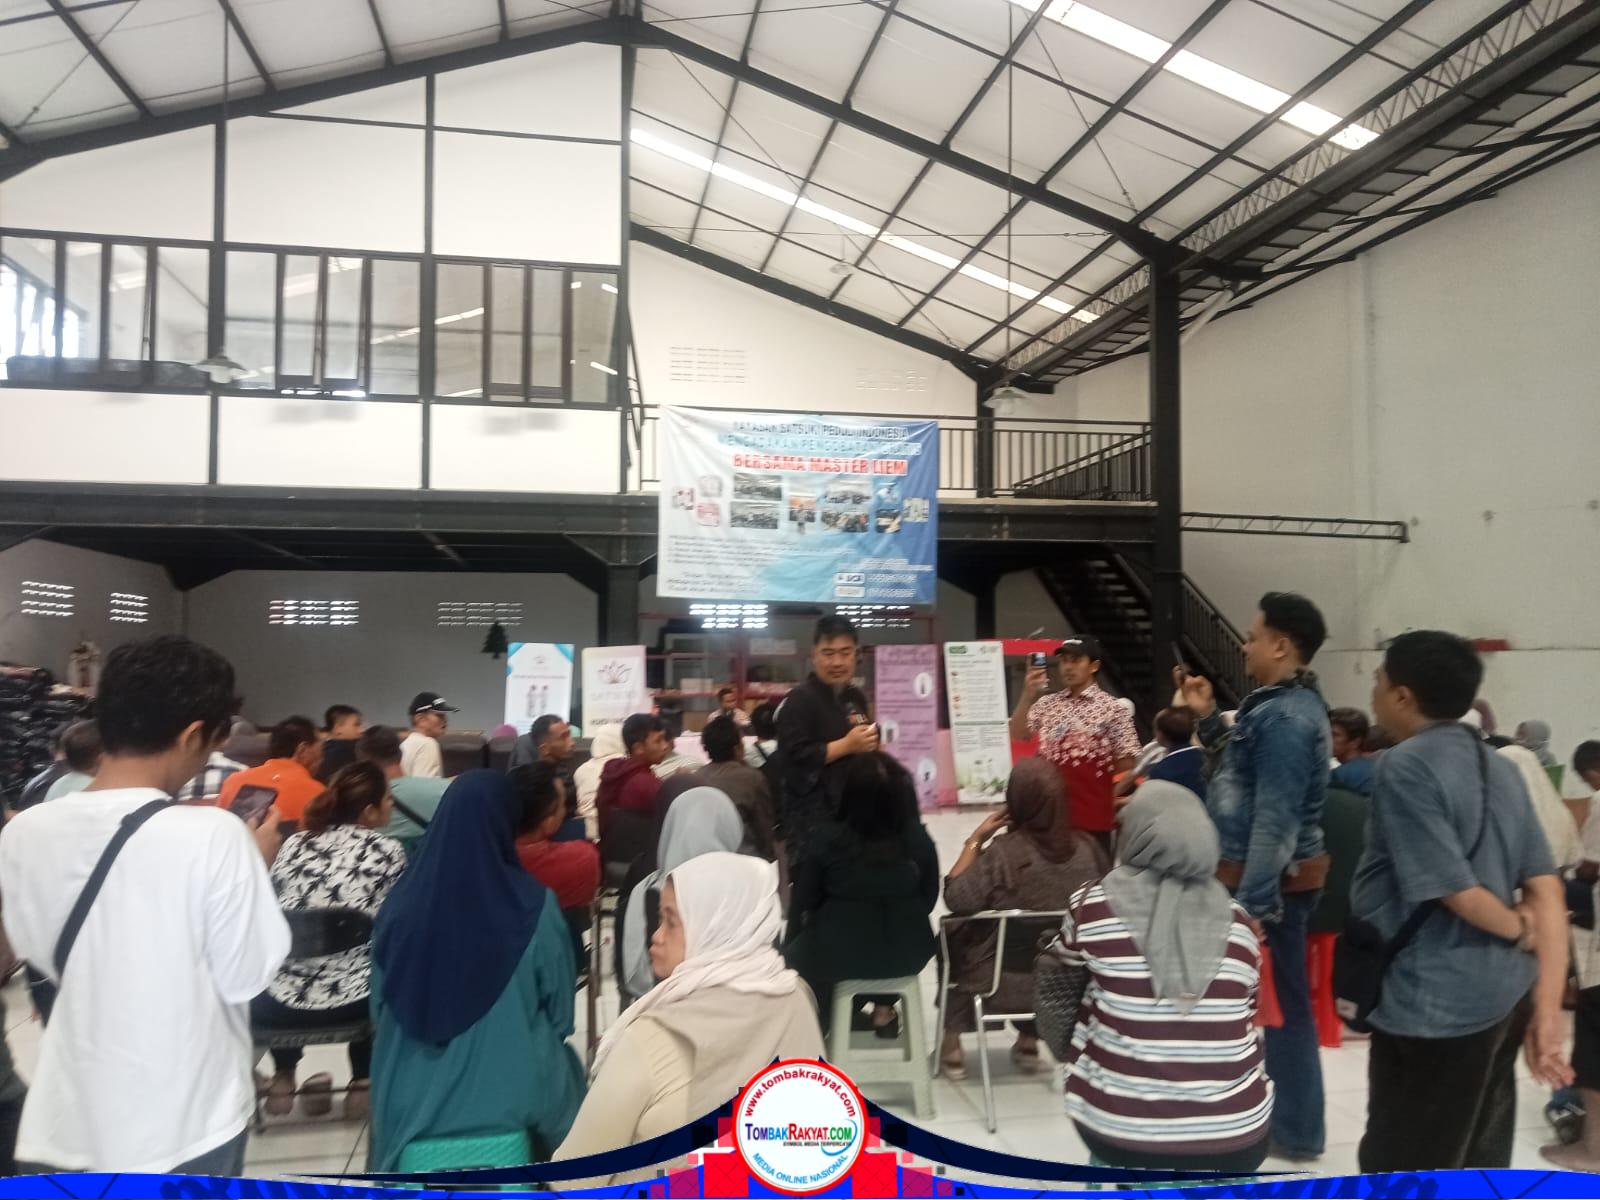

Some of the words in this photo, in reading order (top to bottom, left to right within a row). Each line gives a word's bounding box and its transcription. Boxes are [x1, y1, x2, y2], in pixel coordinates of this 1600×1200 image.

[734, 454, 805, 471] BERSAMA
[810, 457, 868, 474] MASTER
[873, 459, 908, 475] LIEM
